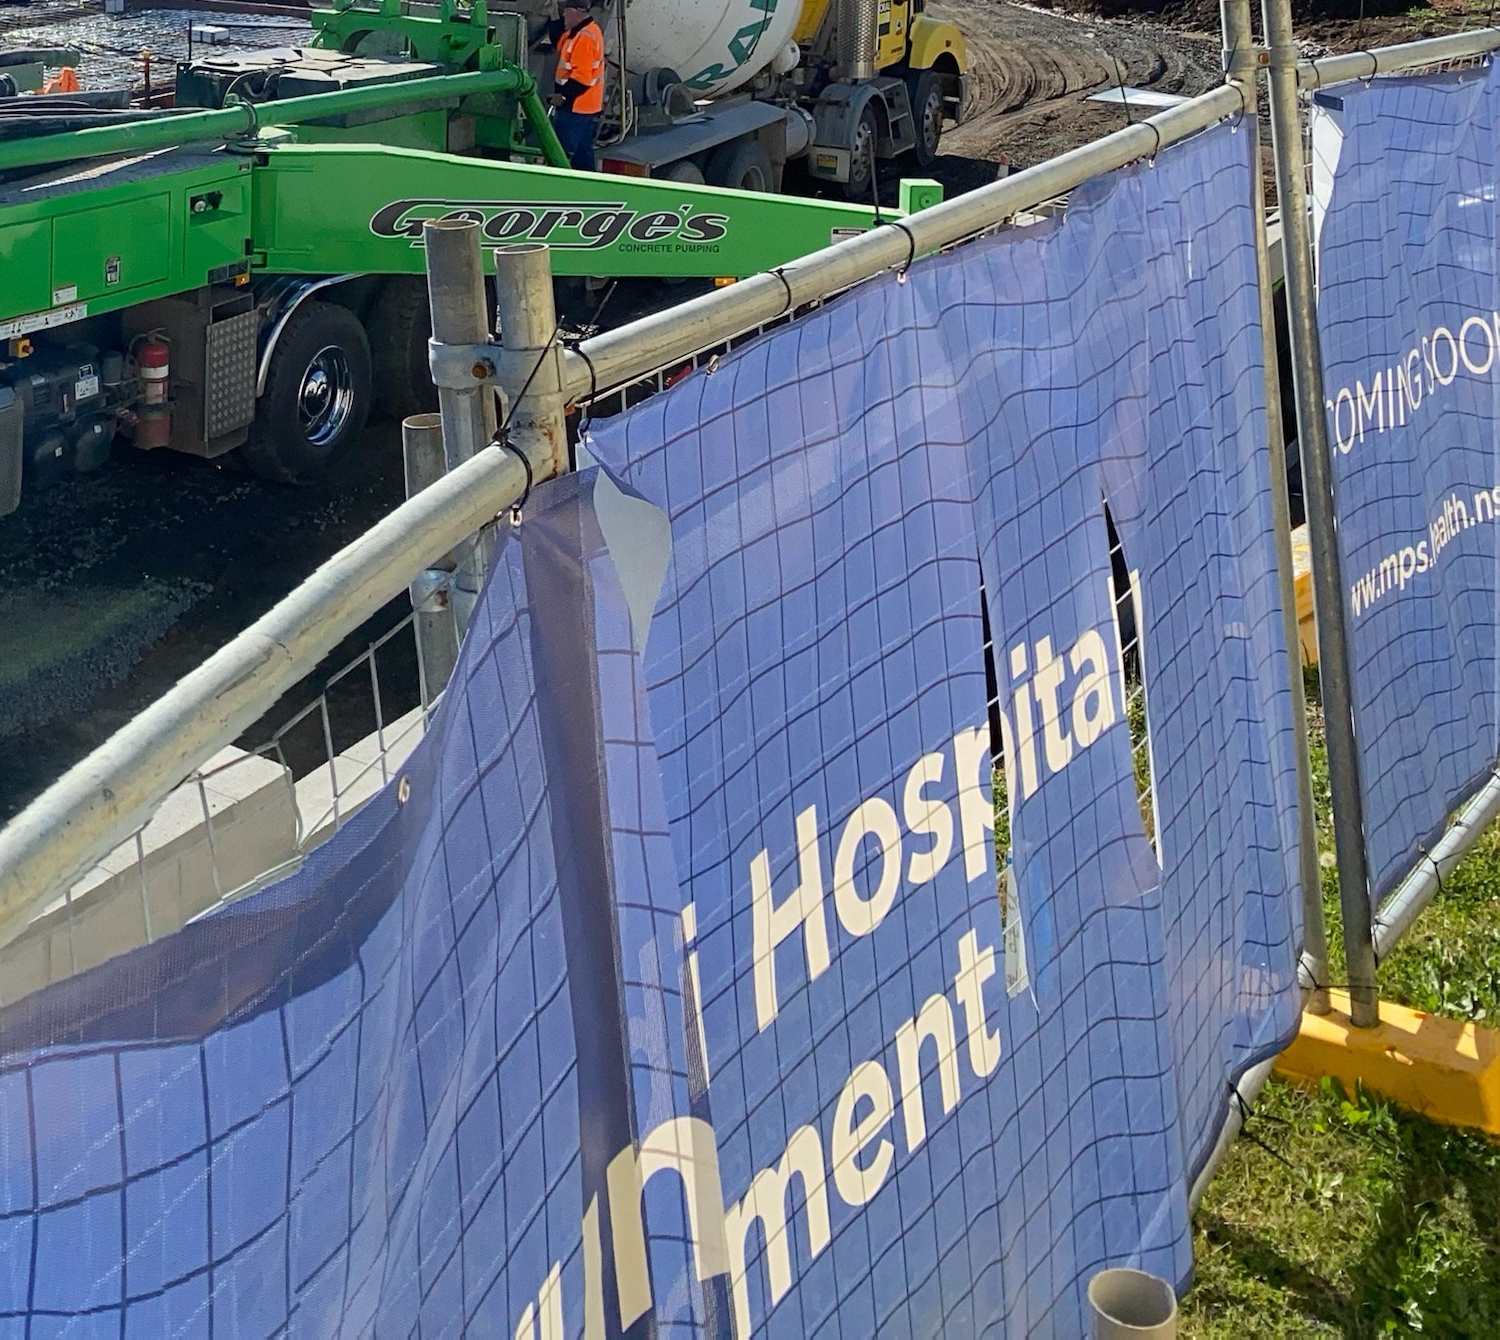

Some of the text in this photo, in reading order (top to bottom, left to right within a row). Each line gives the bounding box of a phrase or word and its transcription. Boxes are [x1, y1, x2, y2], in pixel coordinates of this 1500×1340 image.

[618, 244, 720, 254] CONCRETE PUMPING
[748, 568, 1147, 1034] Hospital
